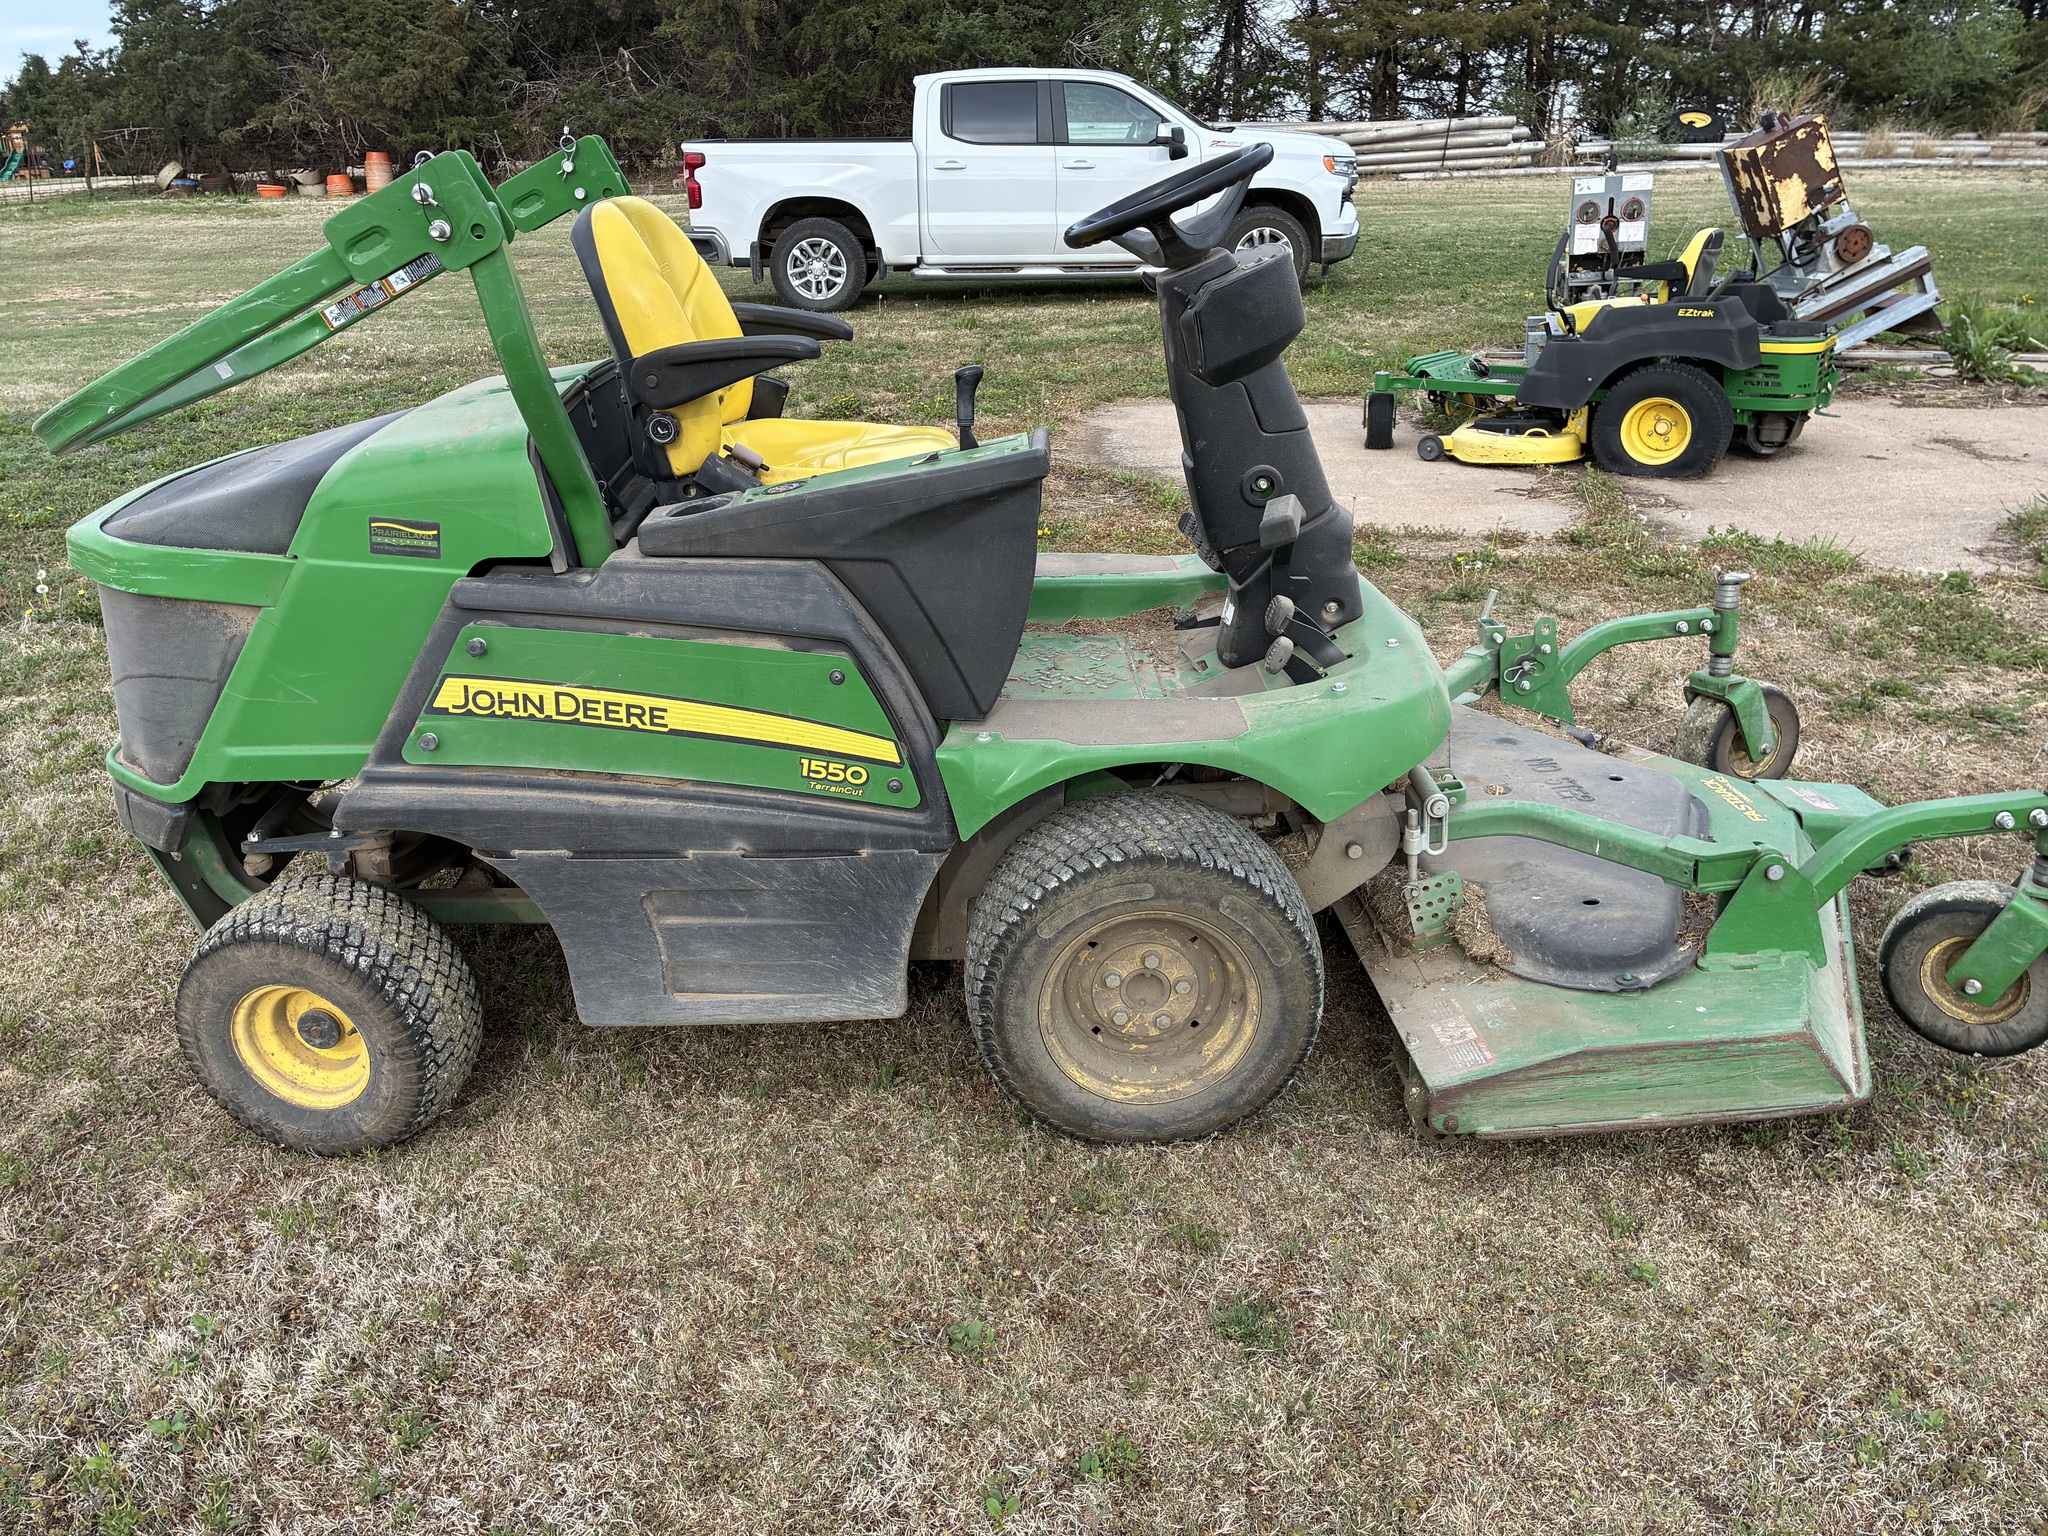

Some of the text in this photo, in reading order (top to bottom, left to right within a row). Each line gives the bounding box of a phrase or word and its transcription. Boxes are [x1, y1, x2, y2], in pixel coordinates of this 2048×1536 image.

[1677, 308, 1715, 318] EZtrak
[371, 527, 433, 541] PRAIRIELAND
[451, 684, 669, 729] JOHN DEERE
[800, 757, 869, 785] 1550
[809, 781, 864, 797] TerrainCut
[1523, 757, 1597, 802] NO STEP
[1699, 778, 1768, 822] FASTBACK
[1237, 1048, 1286, 1106] MULTI
